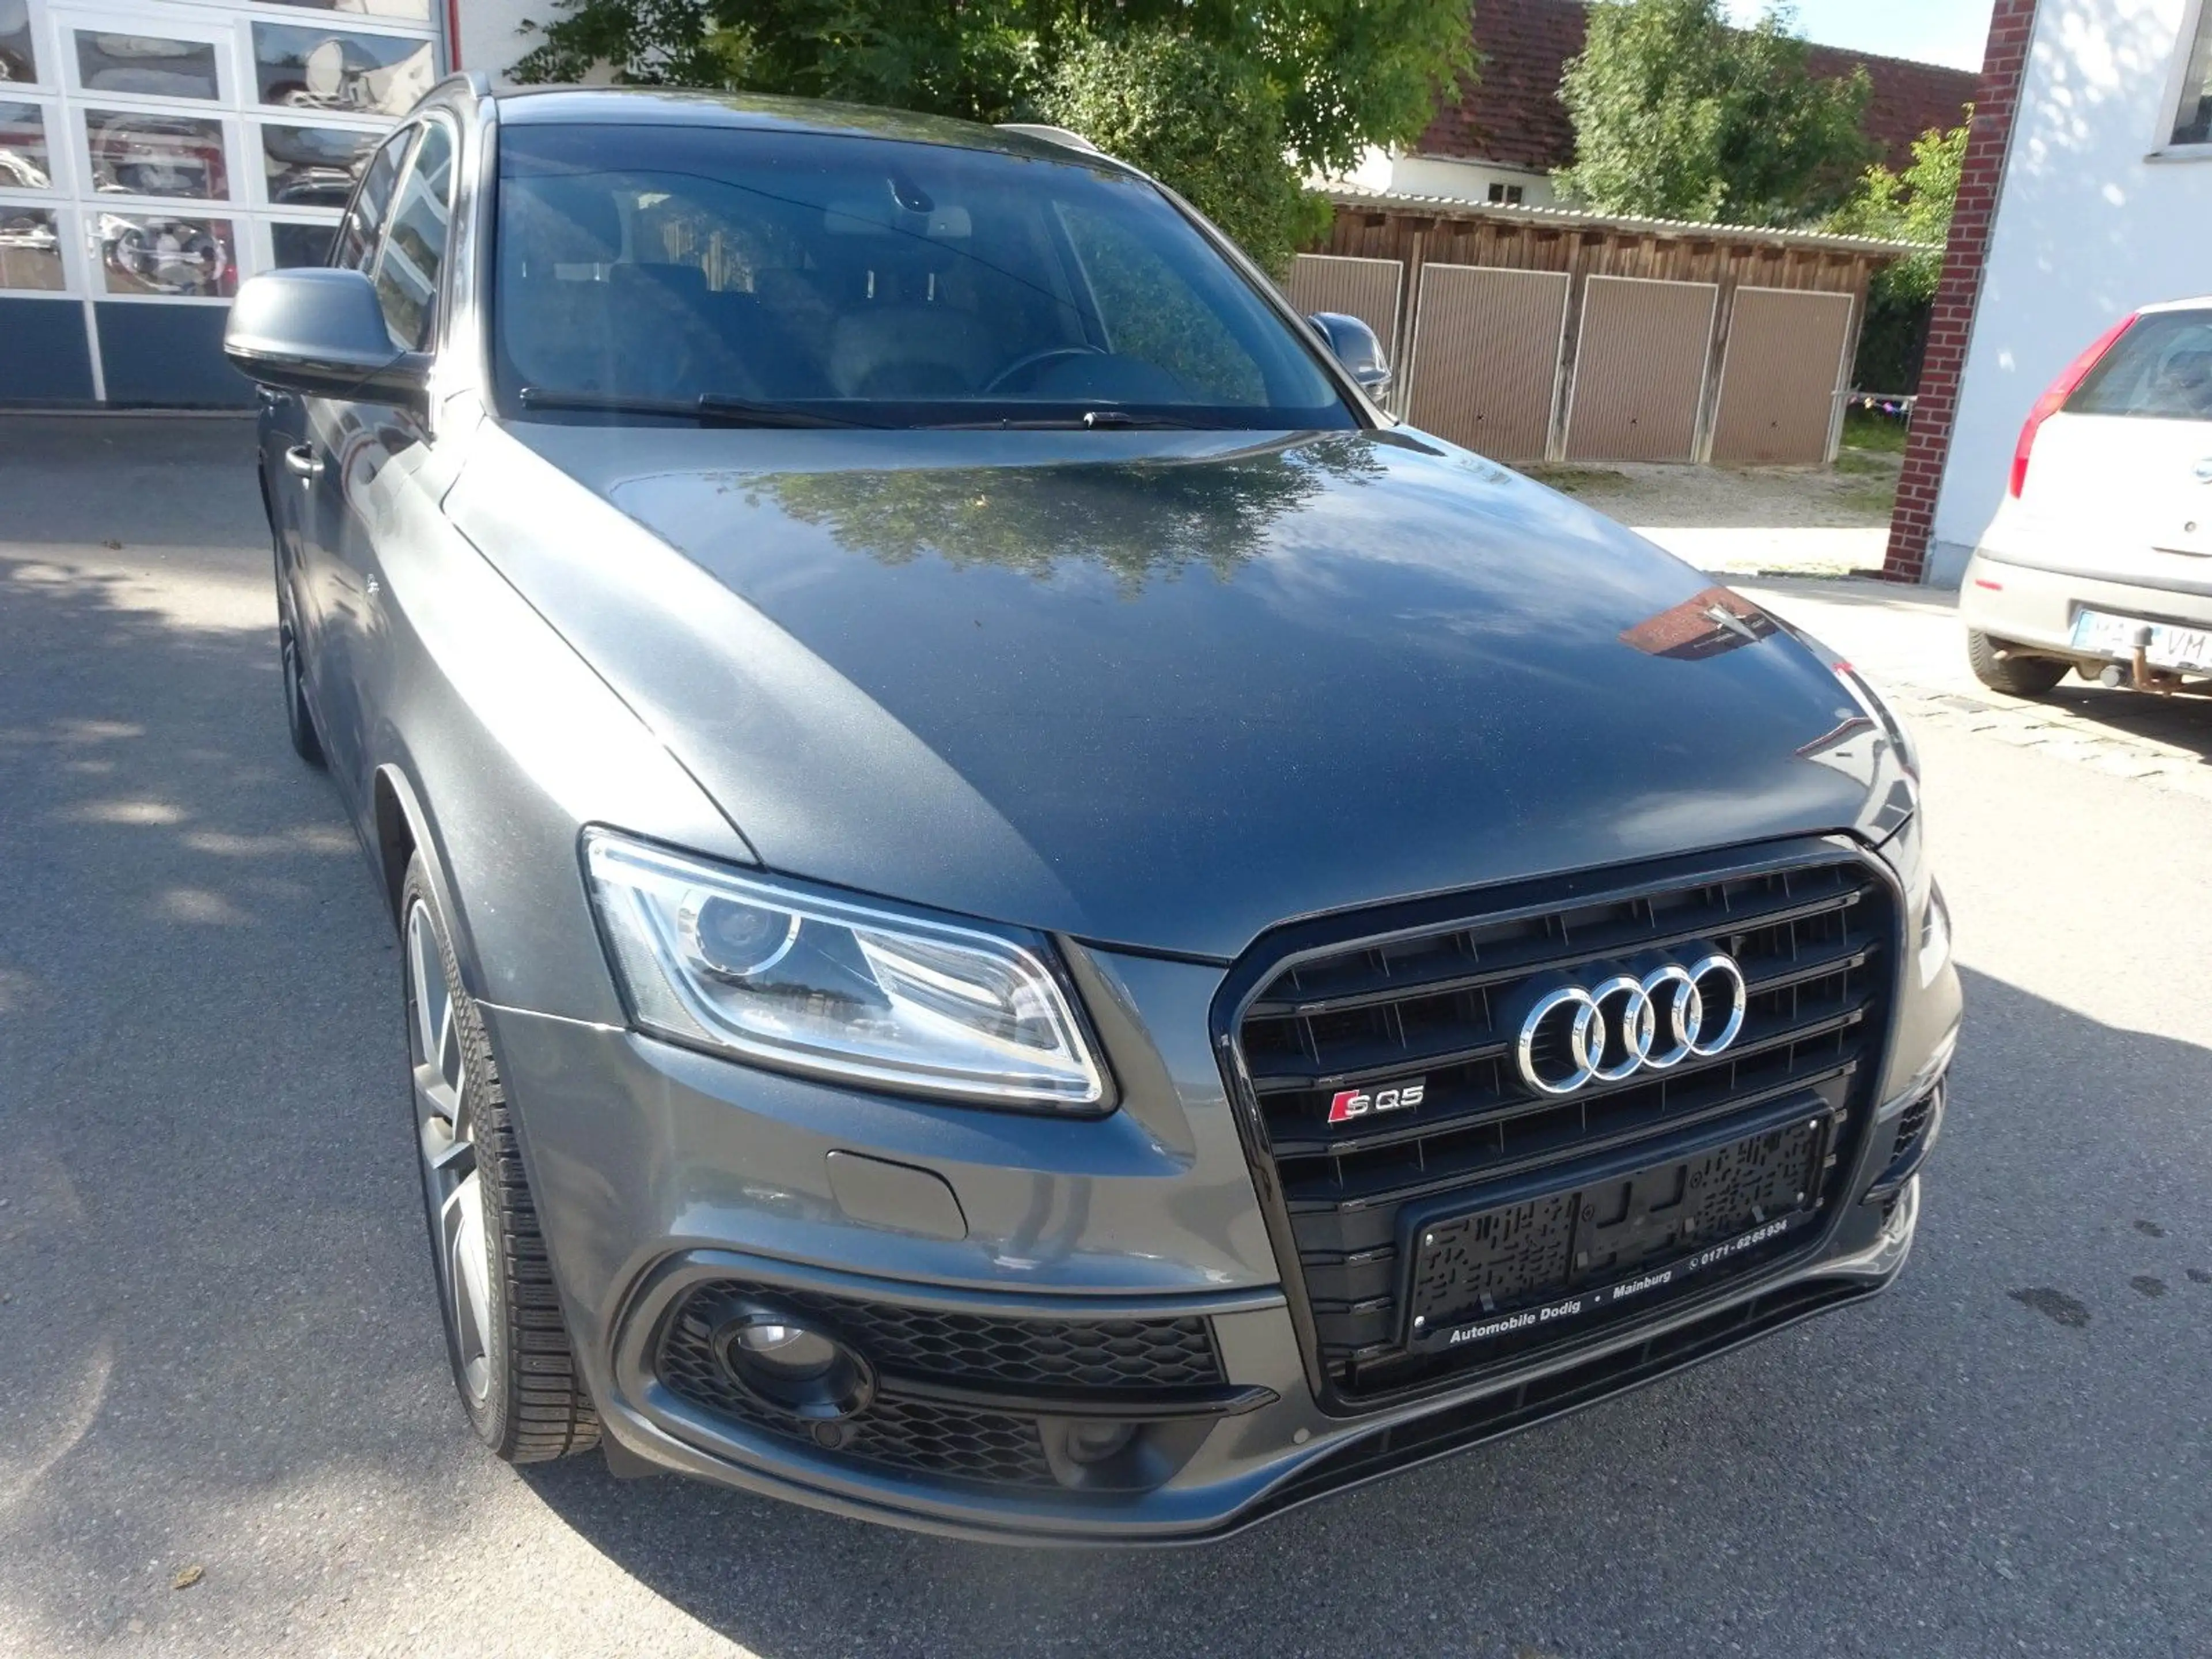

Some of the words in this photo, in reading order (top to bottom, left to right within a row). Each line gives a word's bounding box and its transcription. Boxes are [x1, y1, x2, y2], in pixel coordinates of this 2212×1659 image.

[1344, 1085, 1424, 1116] SQ5
[1449, 1312, 1536, 1344] Automobile
[1540, 1300, 1581, 1321] Dodig
[1613, 1270, 1672, 1299] Mainburg
